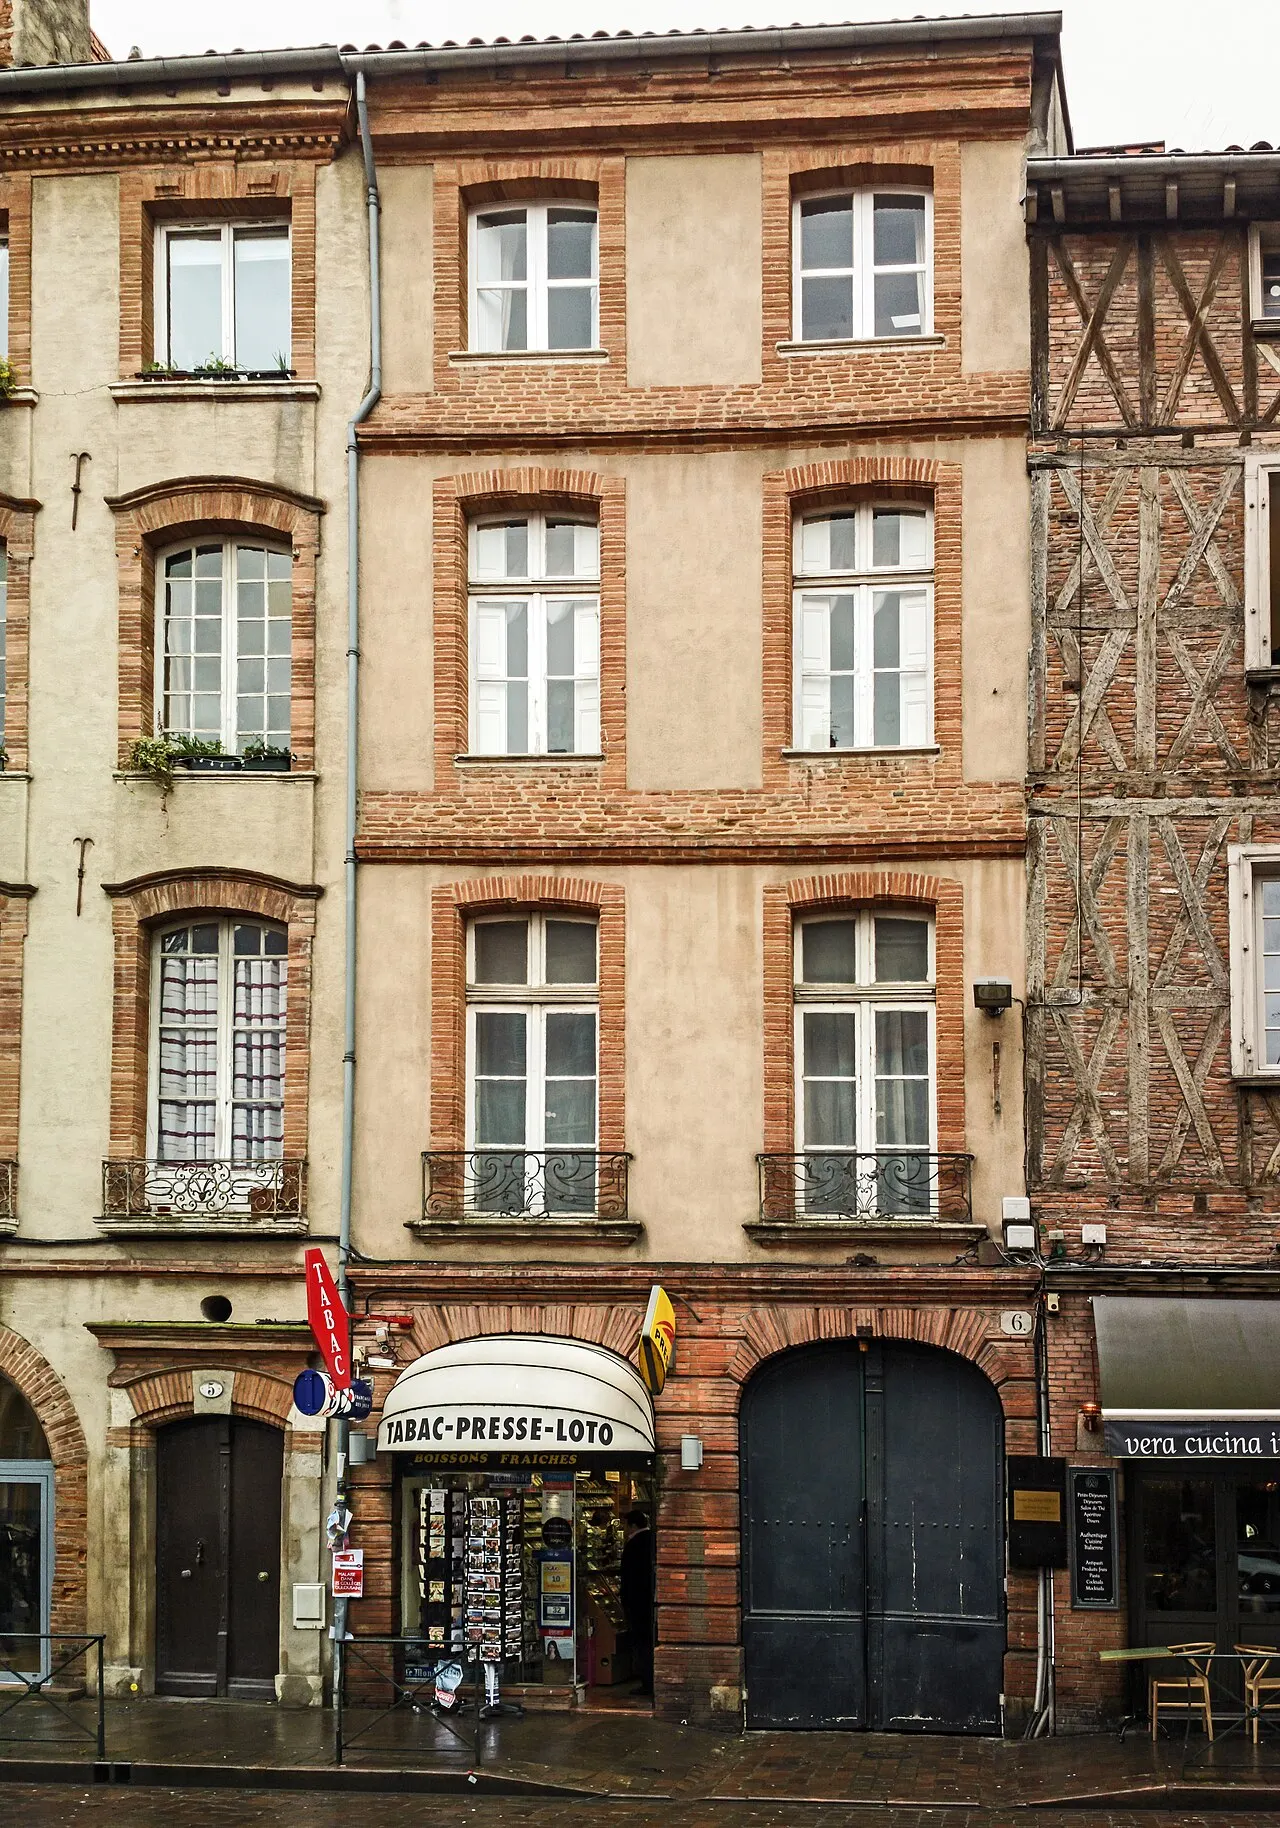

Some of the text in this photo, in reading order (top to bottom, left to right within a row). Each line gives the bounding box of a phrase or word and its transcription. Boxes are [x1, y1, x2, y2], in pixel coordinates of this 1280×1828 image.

[313, 1262, 346, 1376] TABAC
[207, 1382, 215, 1396] 5
[1125, 1437, 1177, 1454] vera
[1184, 1432, 1263, 1454] cucina
[414, 1453, 578, 1464] BOISSONS FRAICHES
[552, 1575, 561, 1583] 10
[552, 1606, 562, 1614] 32
